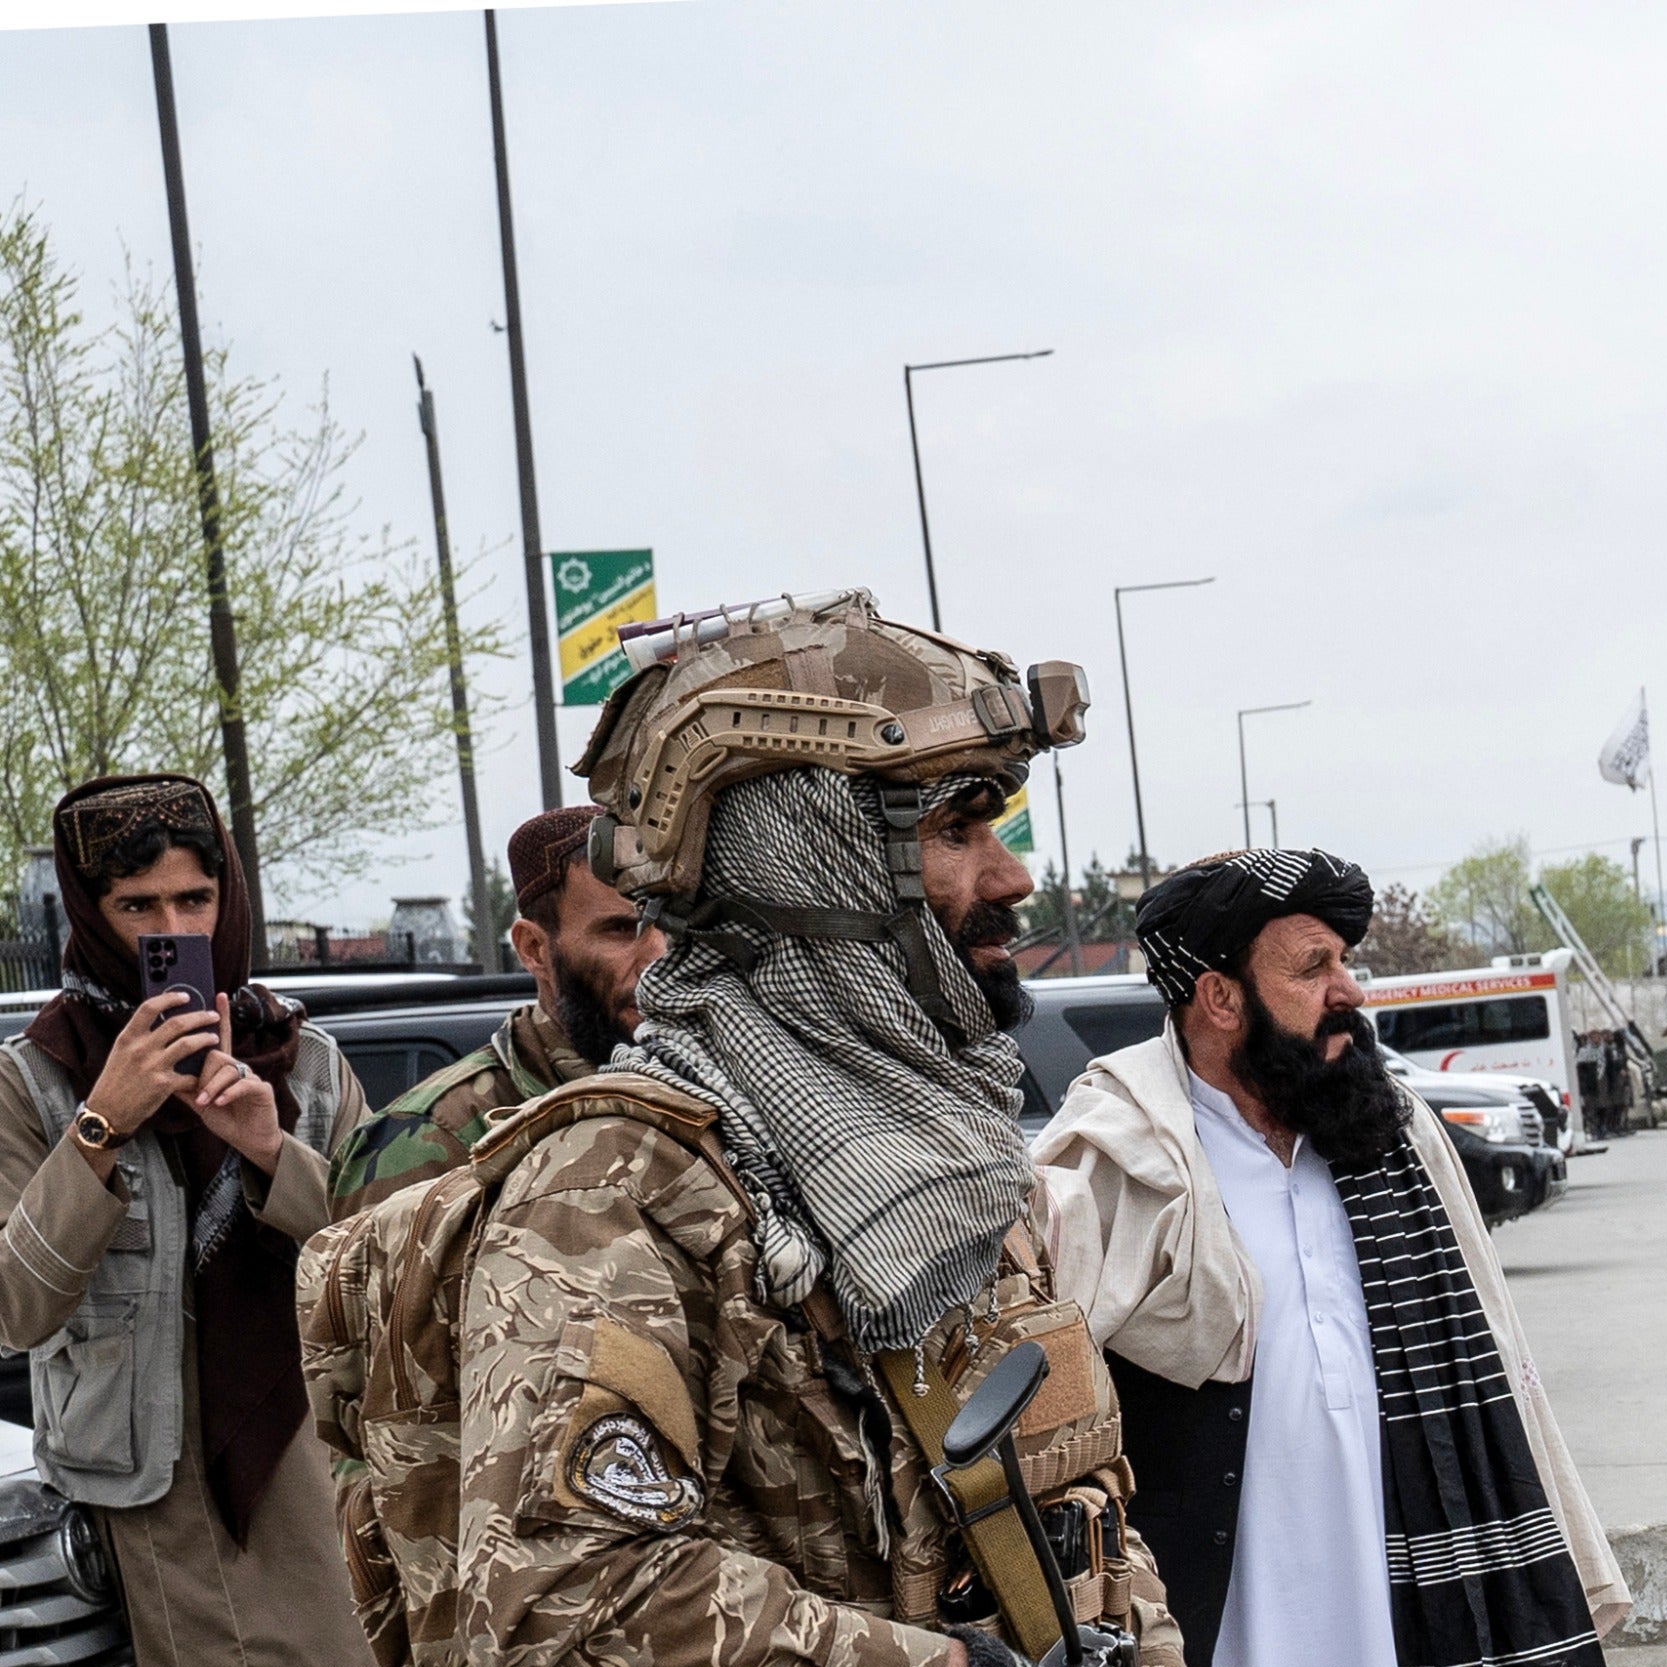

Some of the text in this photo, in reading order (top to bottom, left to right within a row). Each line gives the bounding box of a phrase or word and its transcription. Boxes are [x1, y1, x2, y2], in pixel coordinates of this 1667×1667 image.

[928, 707, 978, 734] EADLIGHT
[1420, 980, 1474, 998] MEDICAL
[1476, 975, 1531, 992] SERVICES
